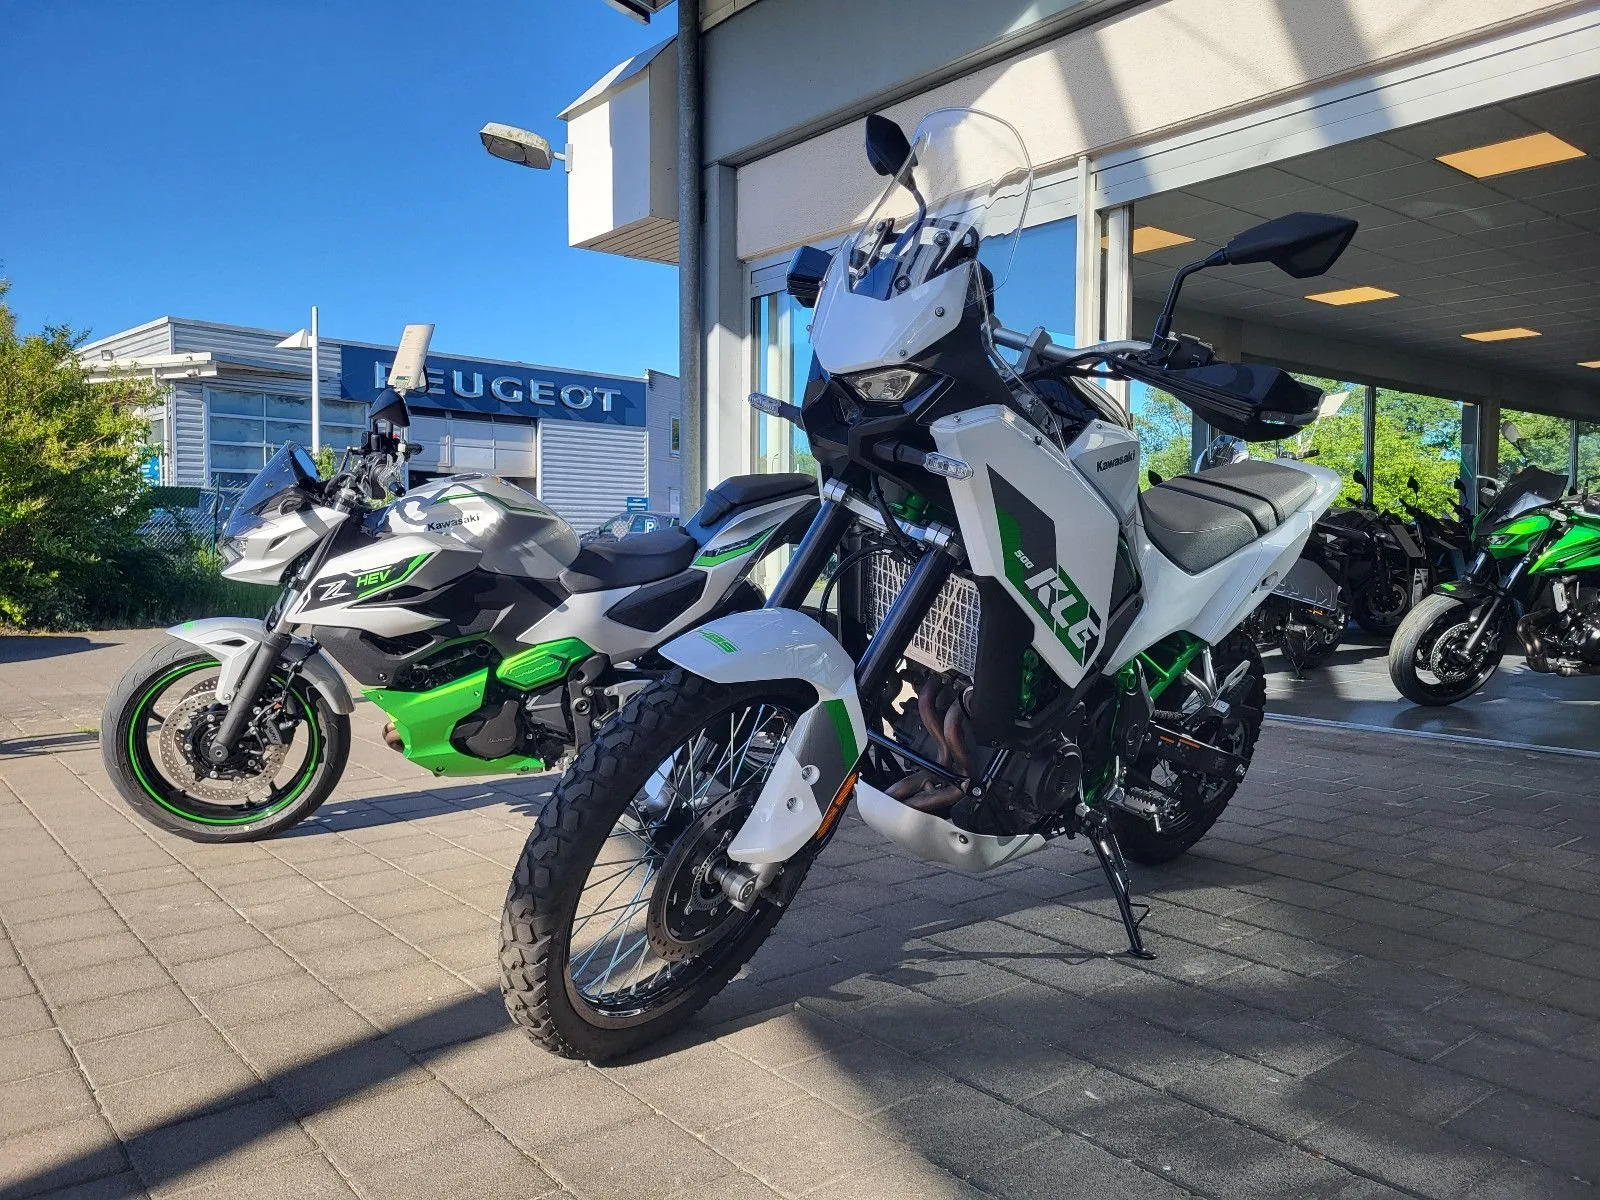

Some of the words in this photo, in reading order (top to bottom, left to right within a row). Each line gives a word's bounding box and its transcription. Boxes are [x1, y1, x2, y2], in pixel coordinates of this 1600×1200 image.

[1096, 451, 1136, 473] Kawasaki
[427, 513, 480, 531] Kawasaki
[646, 521, 655, 533] P
[1014, 550, 1035, 569] 500
[356, 570, 390, 588] HEV
[1024, 567, 1100, 649] KLE
